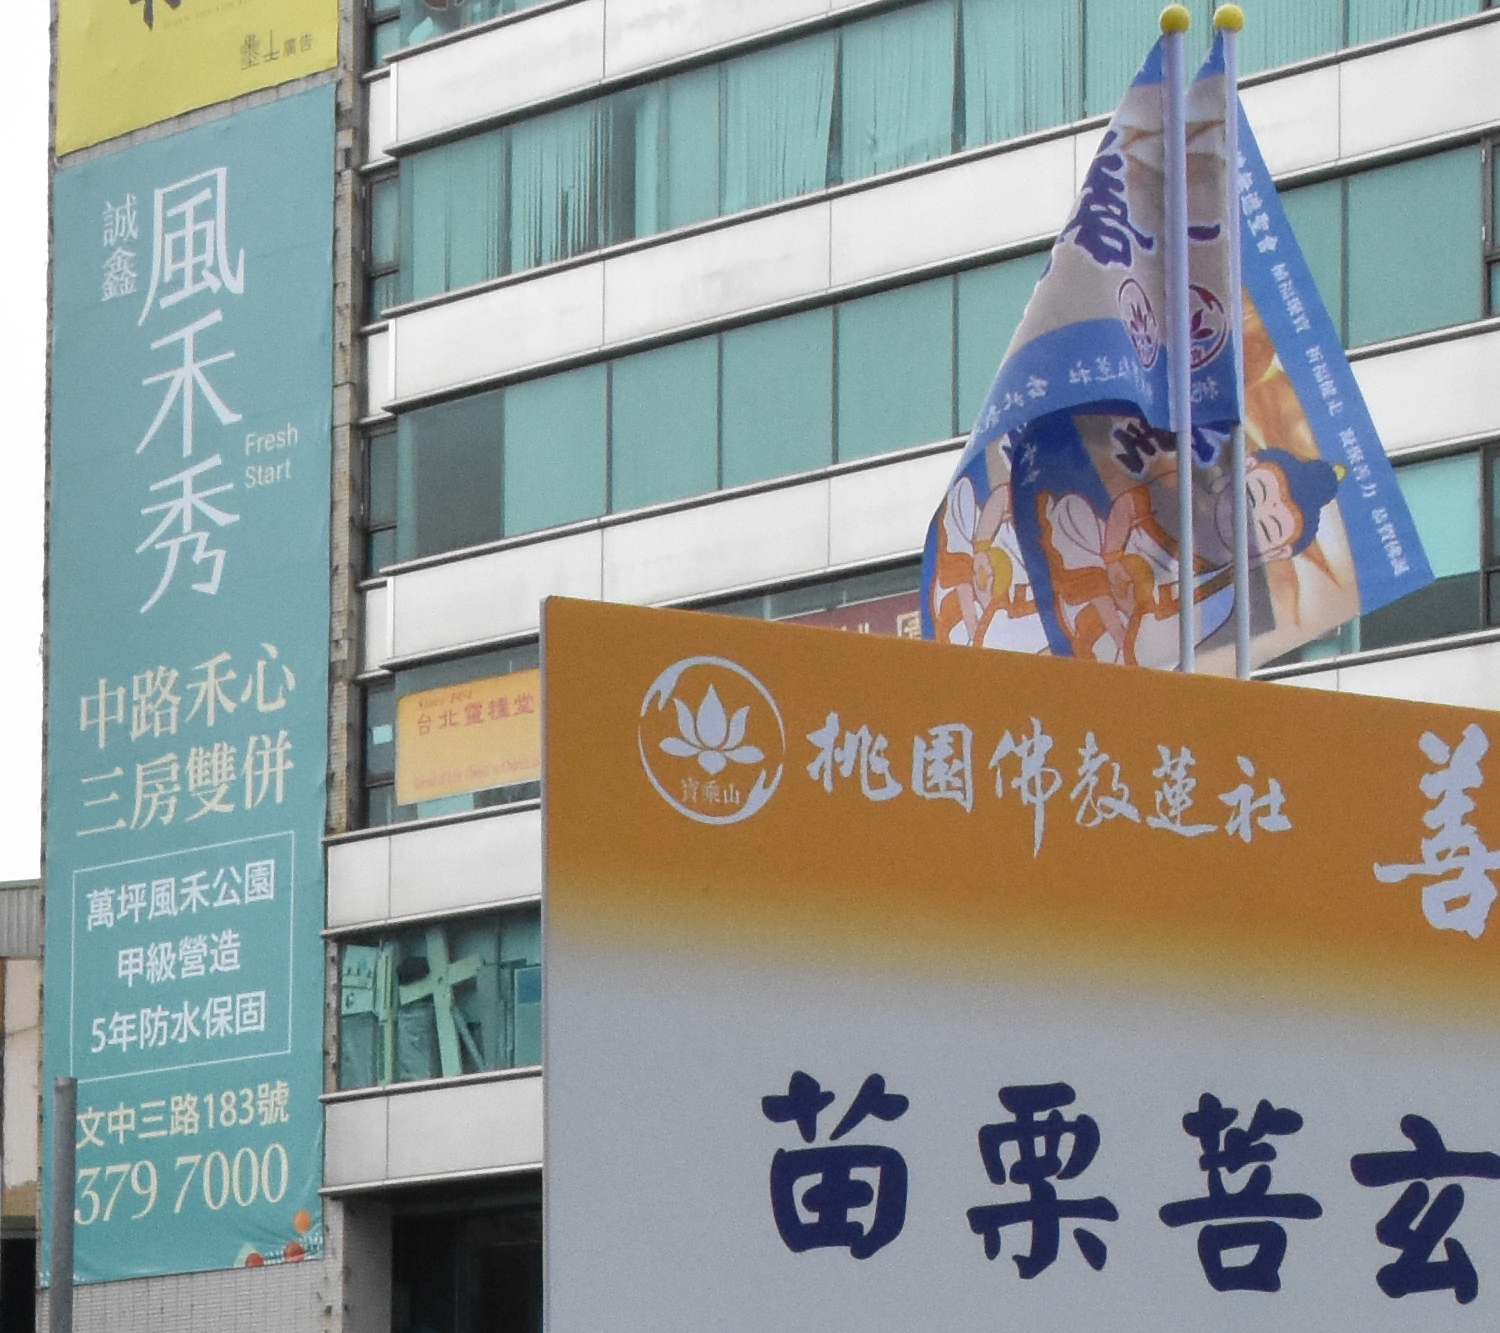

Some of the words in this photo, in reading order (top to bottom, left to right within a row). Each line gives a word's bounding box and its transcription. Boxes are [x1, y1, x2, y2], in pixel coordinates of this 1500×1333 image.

[101, 193, 139, 302] 誠鑫
[135, 165, 246, 613] 風禾秀
[245, 423, 299, 455] Fresh
[245, 458, 293, 488] Start
[78, 642, 297, 750] 中路禾心
[77, 727, 295, 839] 三房雙併
[85, 859, 276, 932] 萬坪風禾公園
[116, 931, 242, 989] 甲級營造
[90, 990, 267, 1055] 5年防水保固
[76, 1080, 291, 1151] 文中三路183號
[74, 1158, 159, 1226] 379
[175, 1143, 290, 1212] 7000
